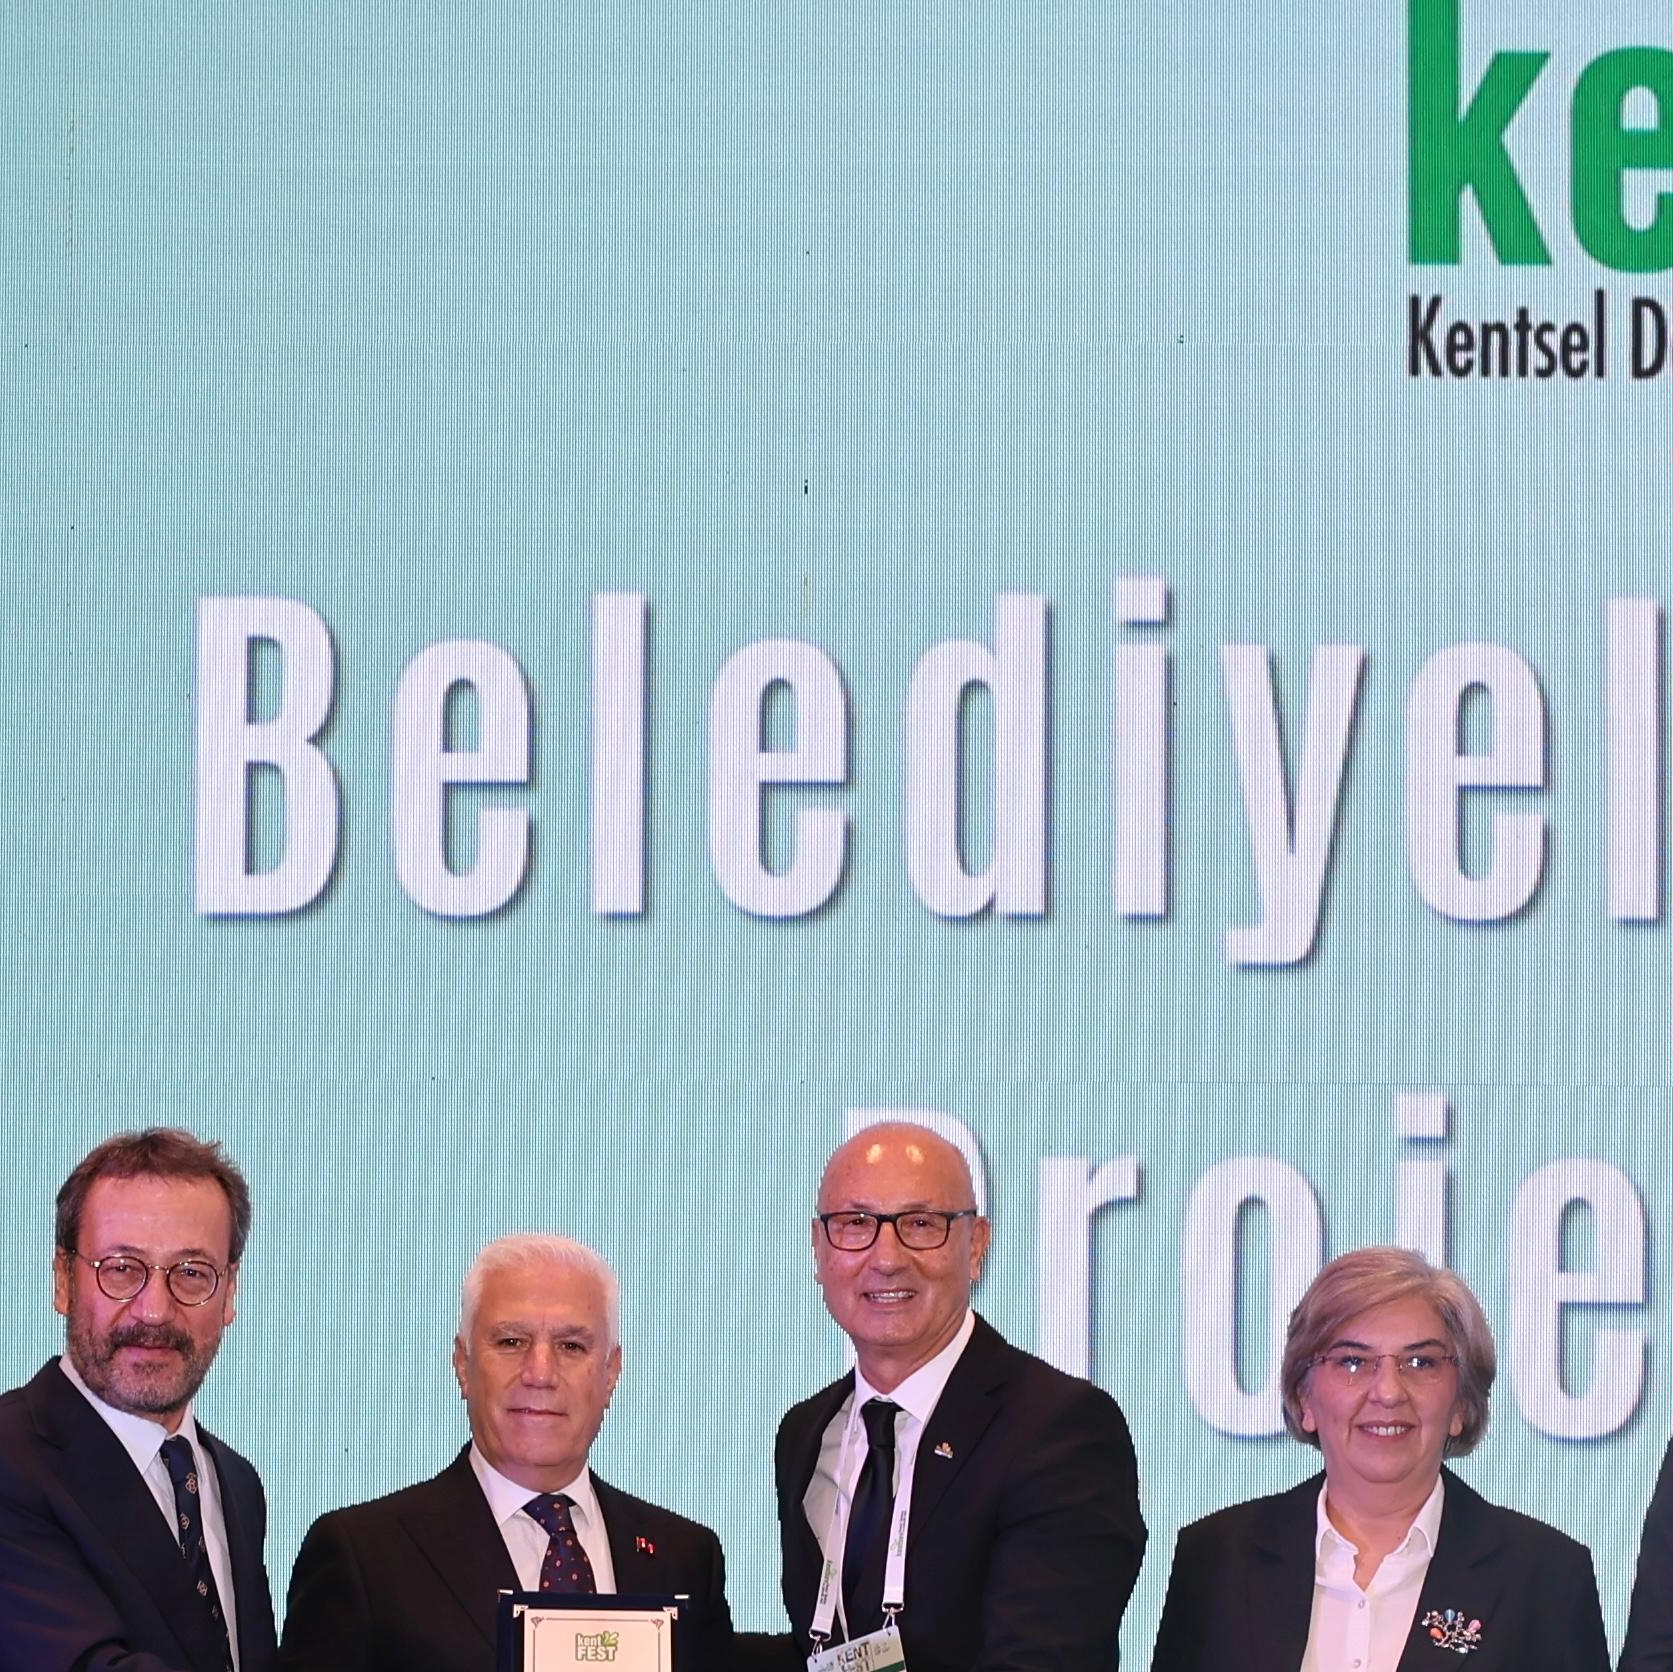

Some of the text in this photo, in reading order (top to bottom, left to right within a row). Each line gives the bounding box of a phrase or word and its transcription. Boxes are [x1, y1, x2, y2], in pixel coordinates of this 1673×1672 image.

[1409, 289, 1606, 379] Kentsel
[844, 1092, 1650, 1444] roe
[577, 1634, 602, 1646] kent
[577, 1646, 616, 1660] FEST
